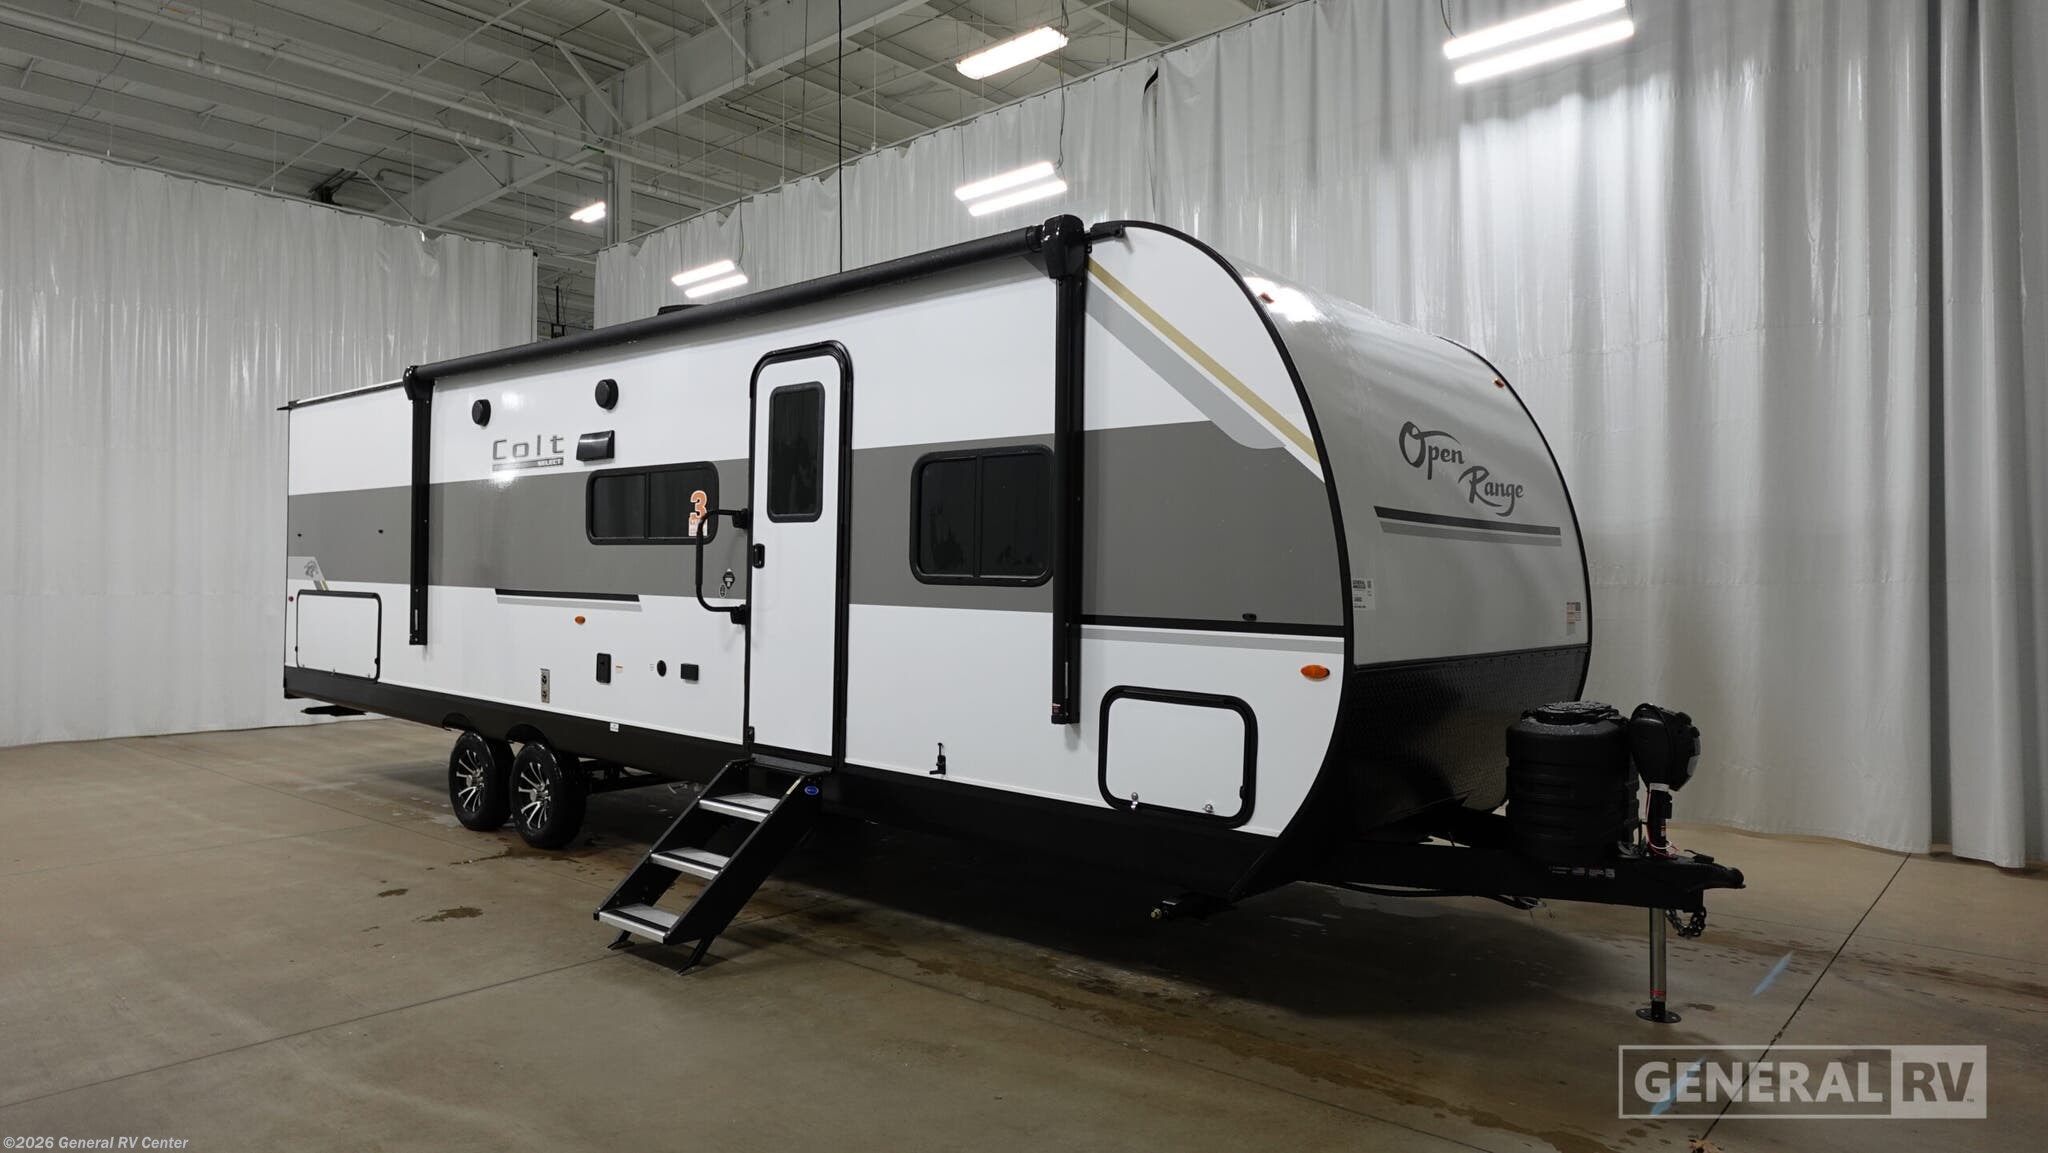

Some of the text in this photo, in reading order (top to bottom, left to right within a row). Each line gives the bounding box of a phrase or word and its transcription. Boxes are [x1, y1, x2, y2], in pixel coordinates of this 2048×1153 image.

[493, 435, 564, 460] Colt
[1399, 421, 1524, 517] Open Range
